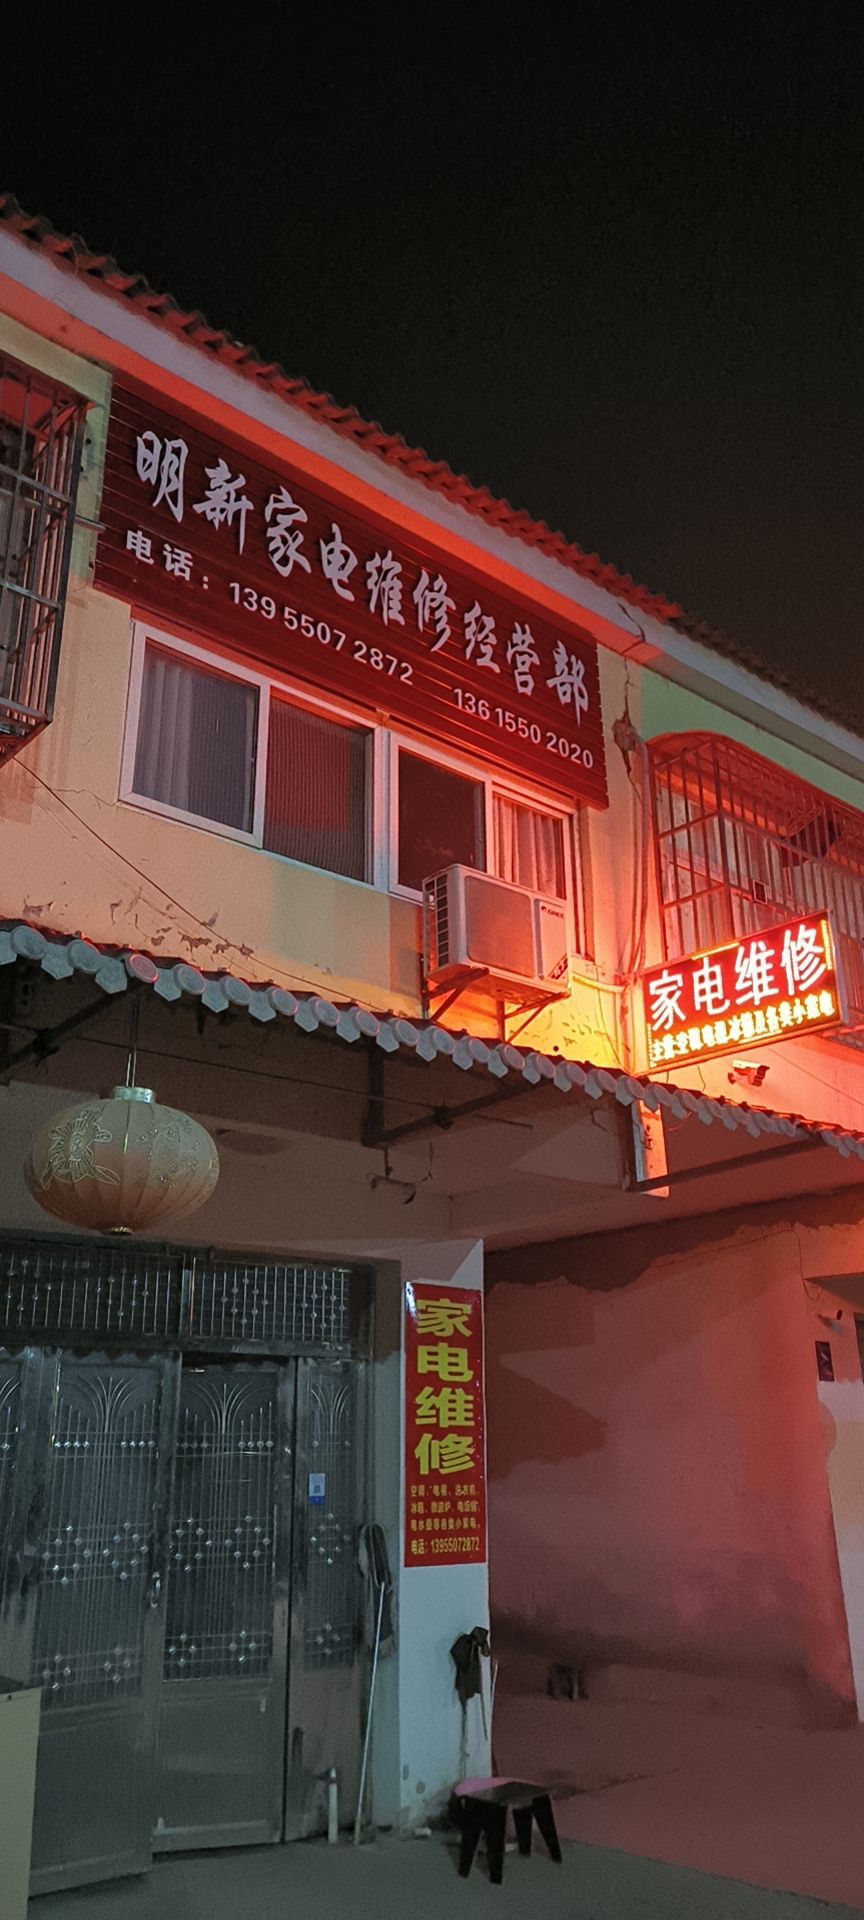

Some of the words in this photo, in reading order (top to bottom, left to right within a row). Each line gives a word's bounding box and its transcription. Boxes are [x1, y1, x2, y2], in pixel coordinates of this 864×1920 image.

[136, 430, 589, 725] 明新家电维修经营部
[229, 582, 276, 619] 139
[284, 608, 346, 651] 5507
[354, 640, 414, 685] 2872
[454, 688, 491, 720] 136
[496, 707, 542, 744] 1550
[546, 731, 594, 769] 2020
[648, 924, 826, 1031] 家电维修
[415, 1299, 475, 1475] 家电维修
